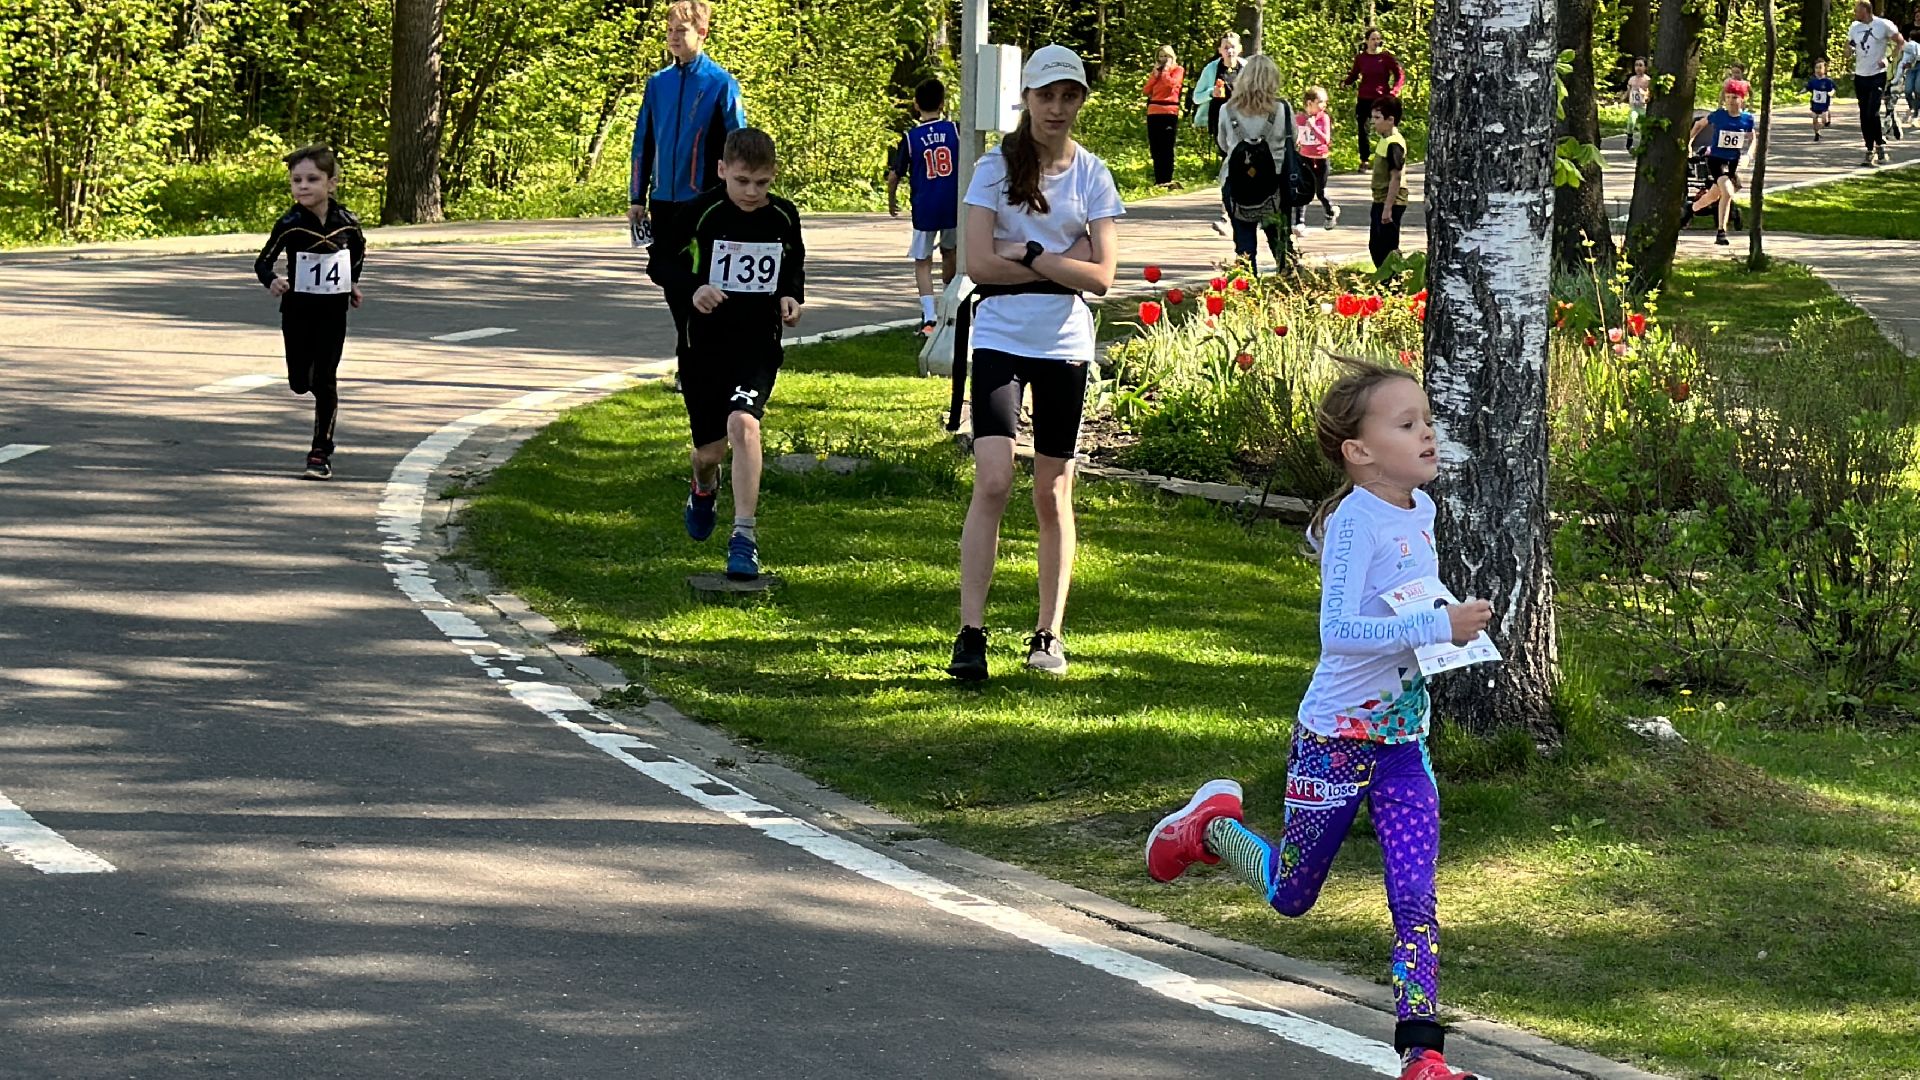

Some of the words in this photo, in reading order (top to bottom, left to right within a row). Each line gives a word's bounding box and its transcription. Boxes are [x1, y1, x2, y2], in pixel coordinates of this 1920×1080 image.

[920, 132, 946, 146] LEON
[1724, 135, 1739, 146] 96
[923, 145, 952, 180] 18
[310, 261, 341, 286] 14
[717, 253, 776, 284] 139
[1328, 783, 1357, 798] lose
